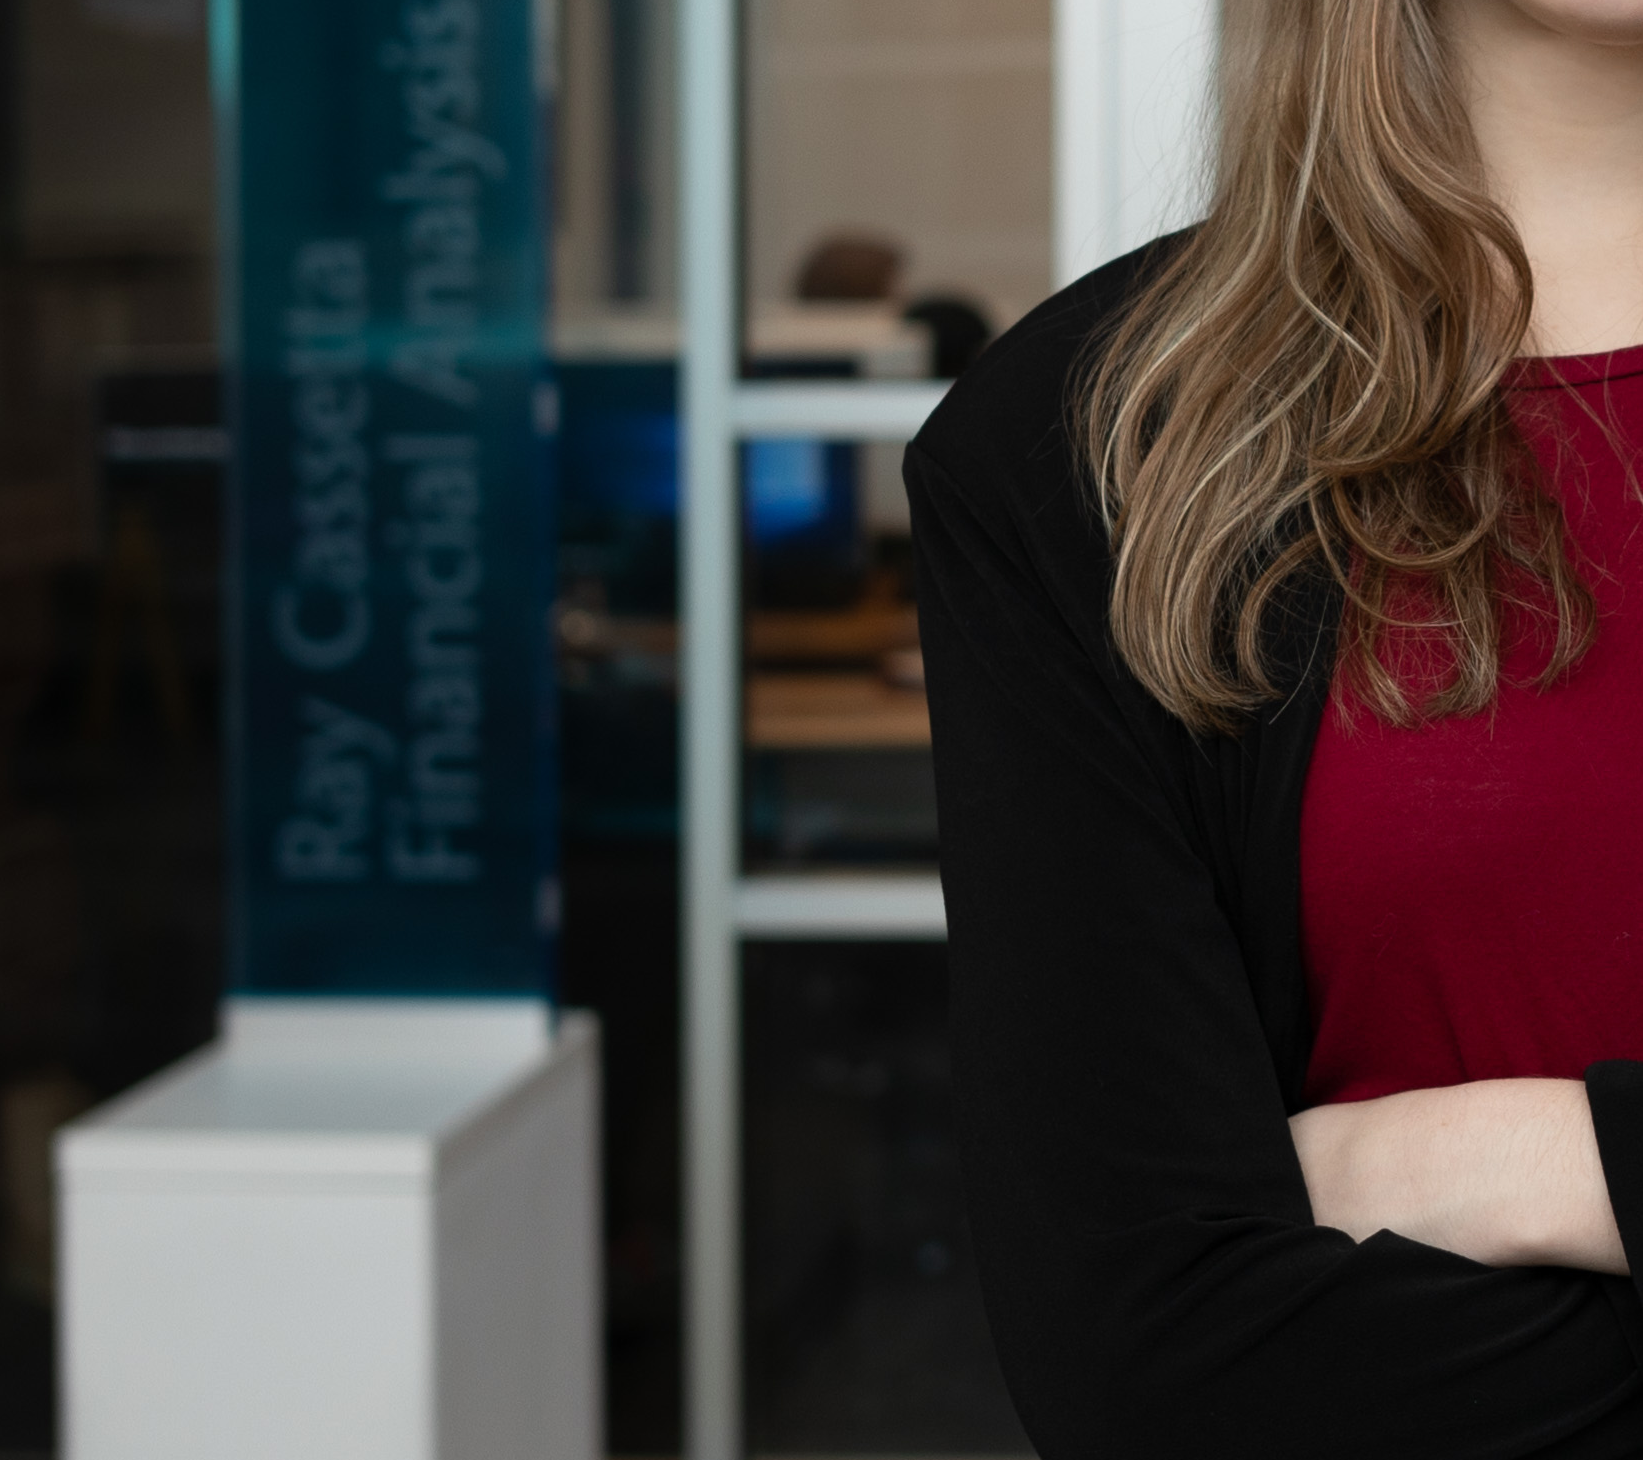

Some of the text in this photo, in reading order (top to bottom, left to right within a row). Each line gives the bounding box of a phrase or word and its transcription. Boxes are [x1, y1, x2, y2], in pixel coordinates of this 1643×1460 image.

[277, 239, 394, 881] Ray Cassetta
[385, 439, 482, 883] Financial
